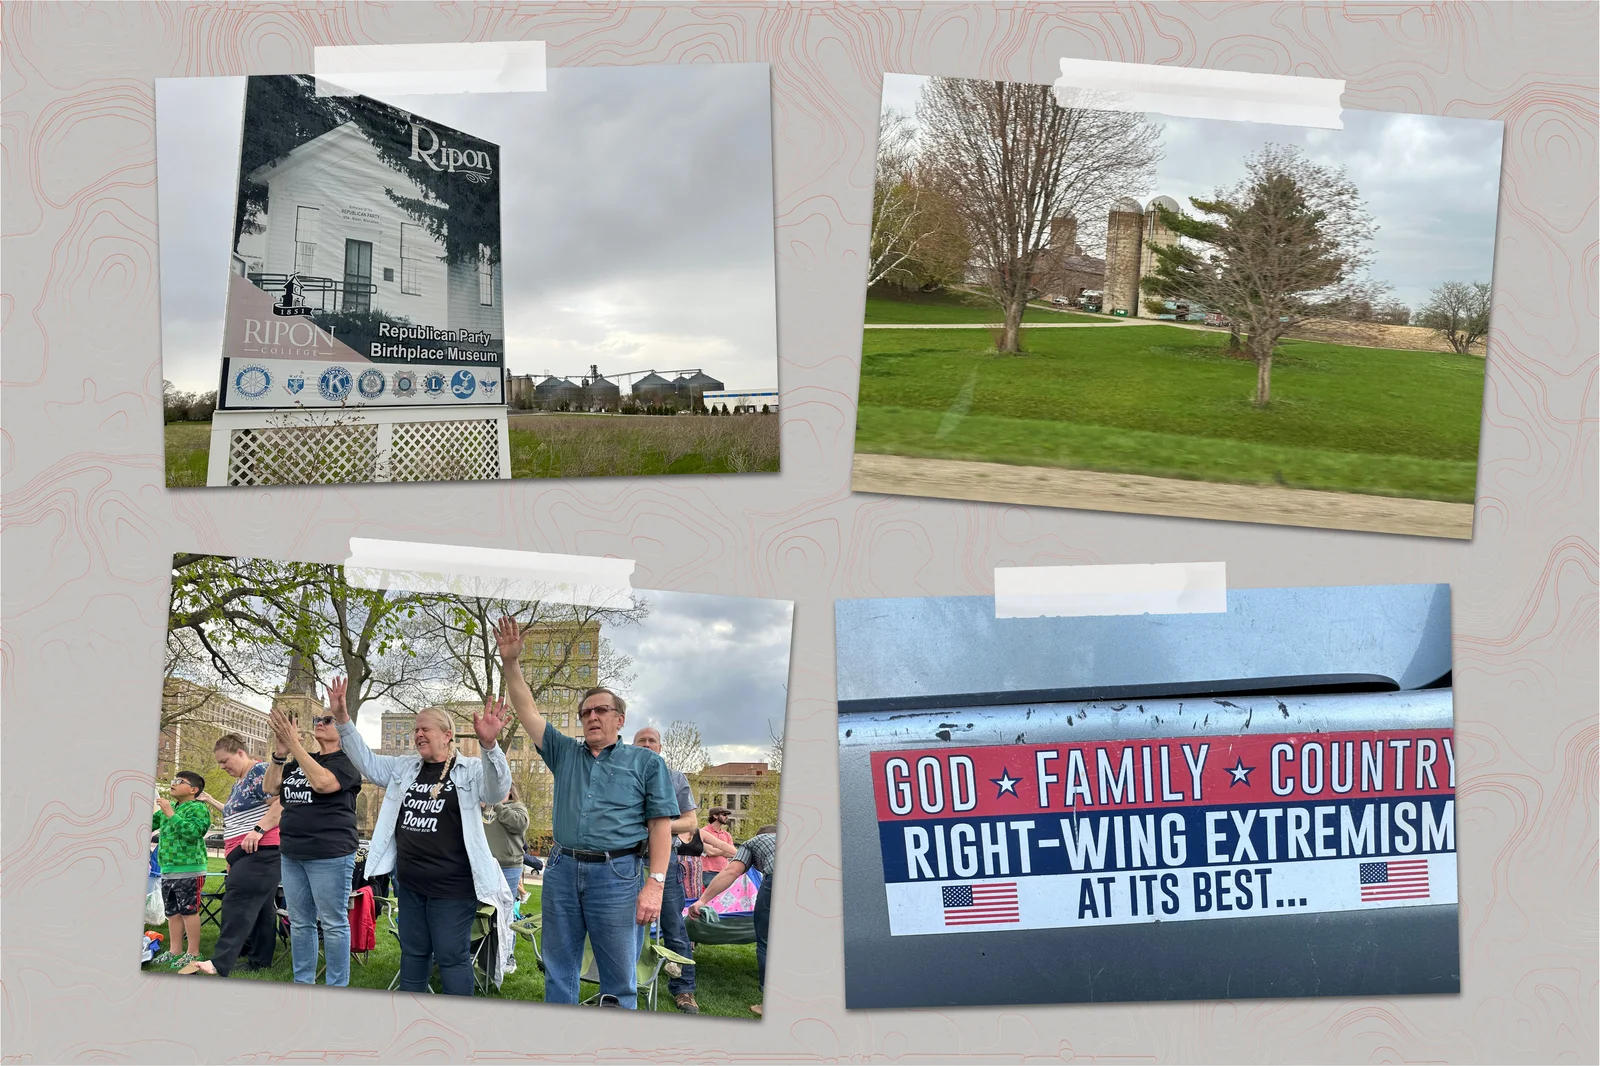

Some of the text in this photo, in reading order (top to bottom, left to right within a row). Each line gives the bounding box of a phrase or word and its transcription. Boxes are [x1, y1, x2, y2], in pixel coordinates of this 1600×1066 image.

[408, 122, 493, 173] Ripon
[280, 307, 305, 315] 1851
[243, 318, 336, 348] RIPON
[379, 321, 491, 346] Republican Party
[260, 346, 318, 357] COLLEGE
[370, 341, 498, 362] Birthplace Museum
[884, 755, 977, 816] GOD
[1035, 743, 1211, 808] FAMILY
[283, 786, 313, 804] Down
[402, 792, 446, 814] Coming
[402, 810, 438, 832] Down
[904, 800, 1455, 879] RIGHT-WING EXTREMISM
[1078, 867, 1308, 919] AT ITS BEST...
